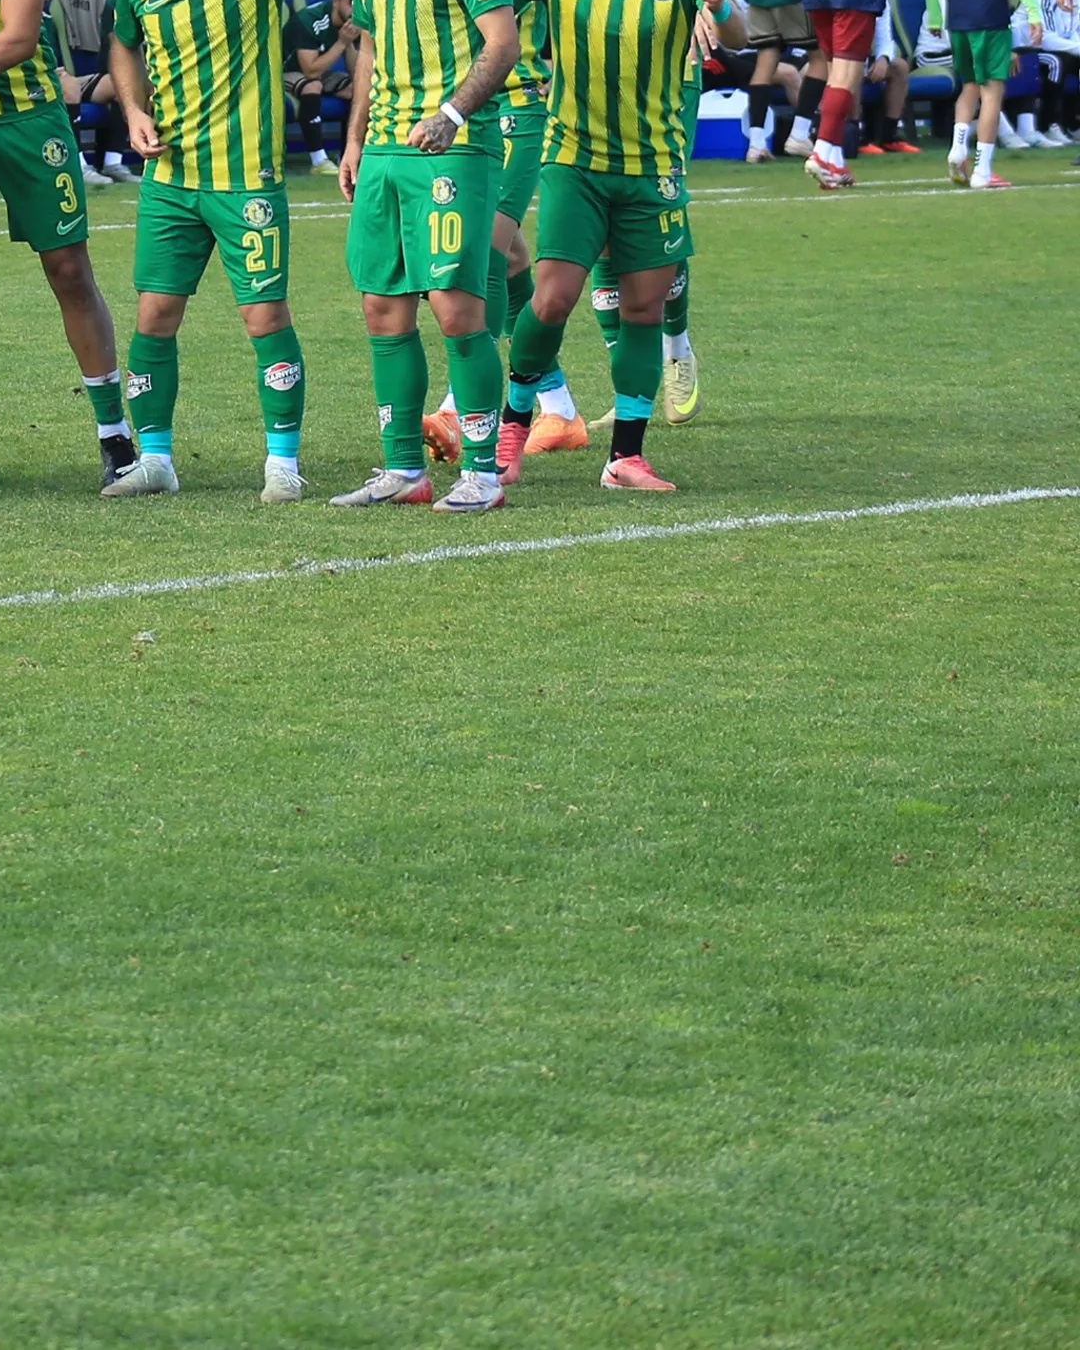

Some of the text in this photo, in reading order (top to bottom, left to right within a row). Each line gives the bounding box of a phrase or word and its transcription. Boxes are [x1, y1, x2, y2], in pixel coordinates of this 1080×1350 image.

[56, 172, 78, 214] 3
[242, 226, 280, 273] 27
[428, 211, 462, 255] 10
